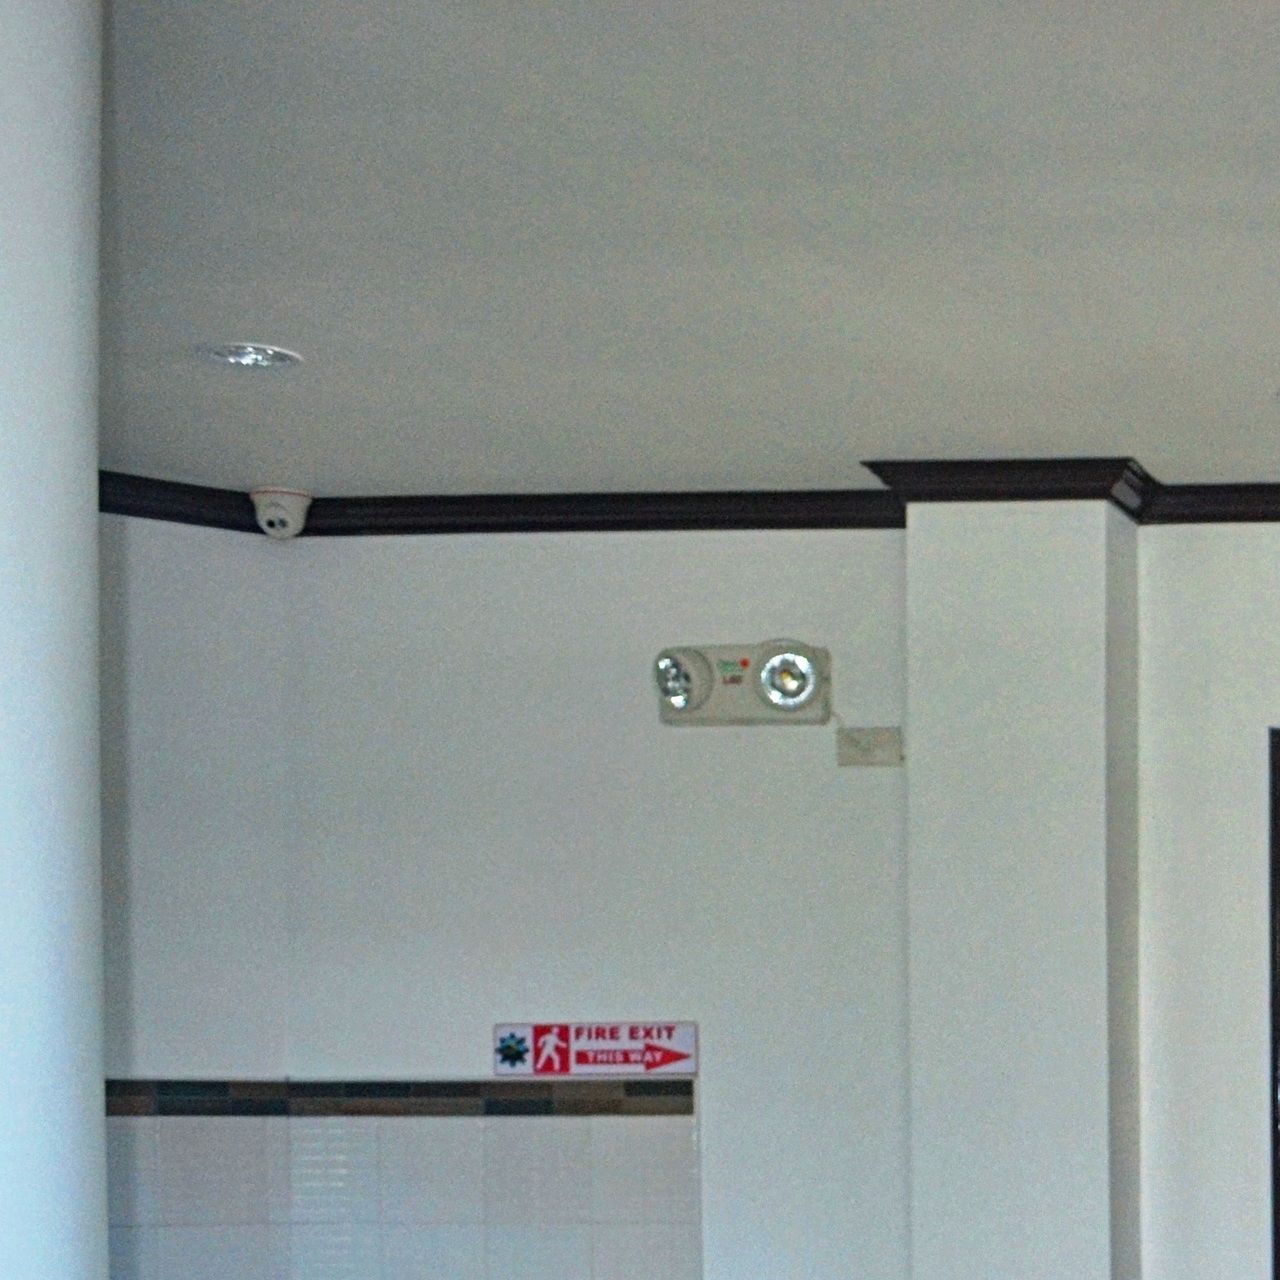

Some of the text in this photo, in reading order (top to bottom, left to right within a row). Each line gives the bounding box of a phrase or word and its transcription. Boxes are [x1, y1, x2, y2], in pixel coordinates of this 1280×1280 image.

[575, 1026, 675, 1040] FIRE EXIT
[586, 1050, 663, 1063] THIS WAY
